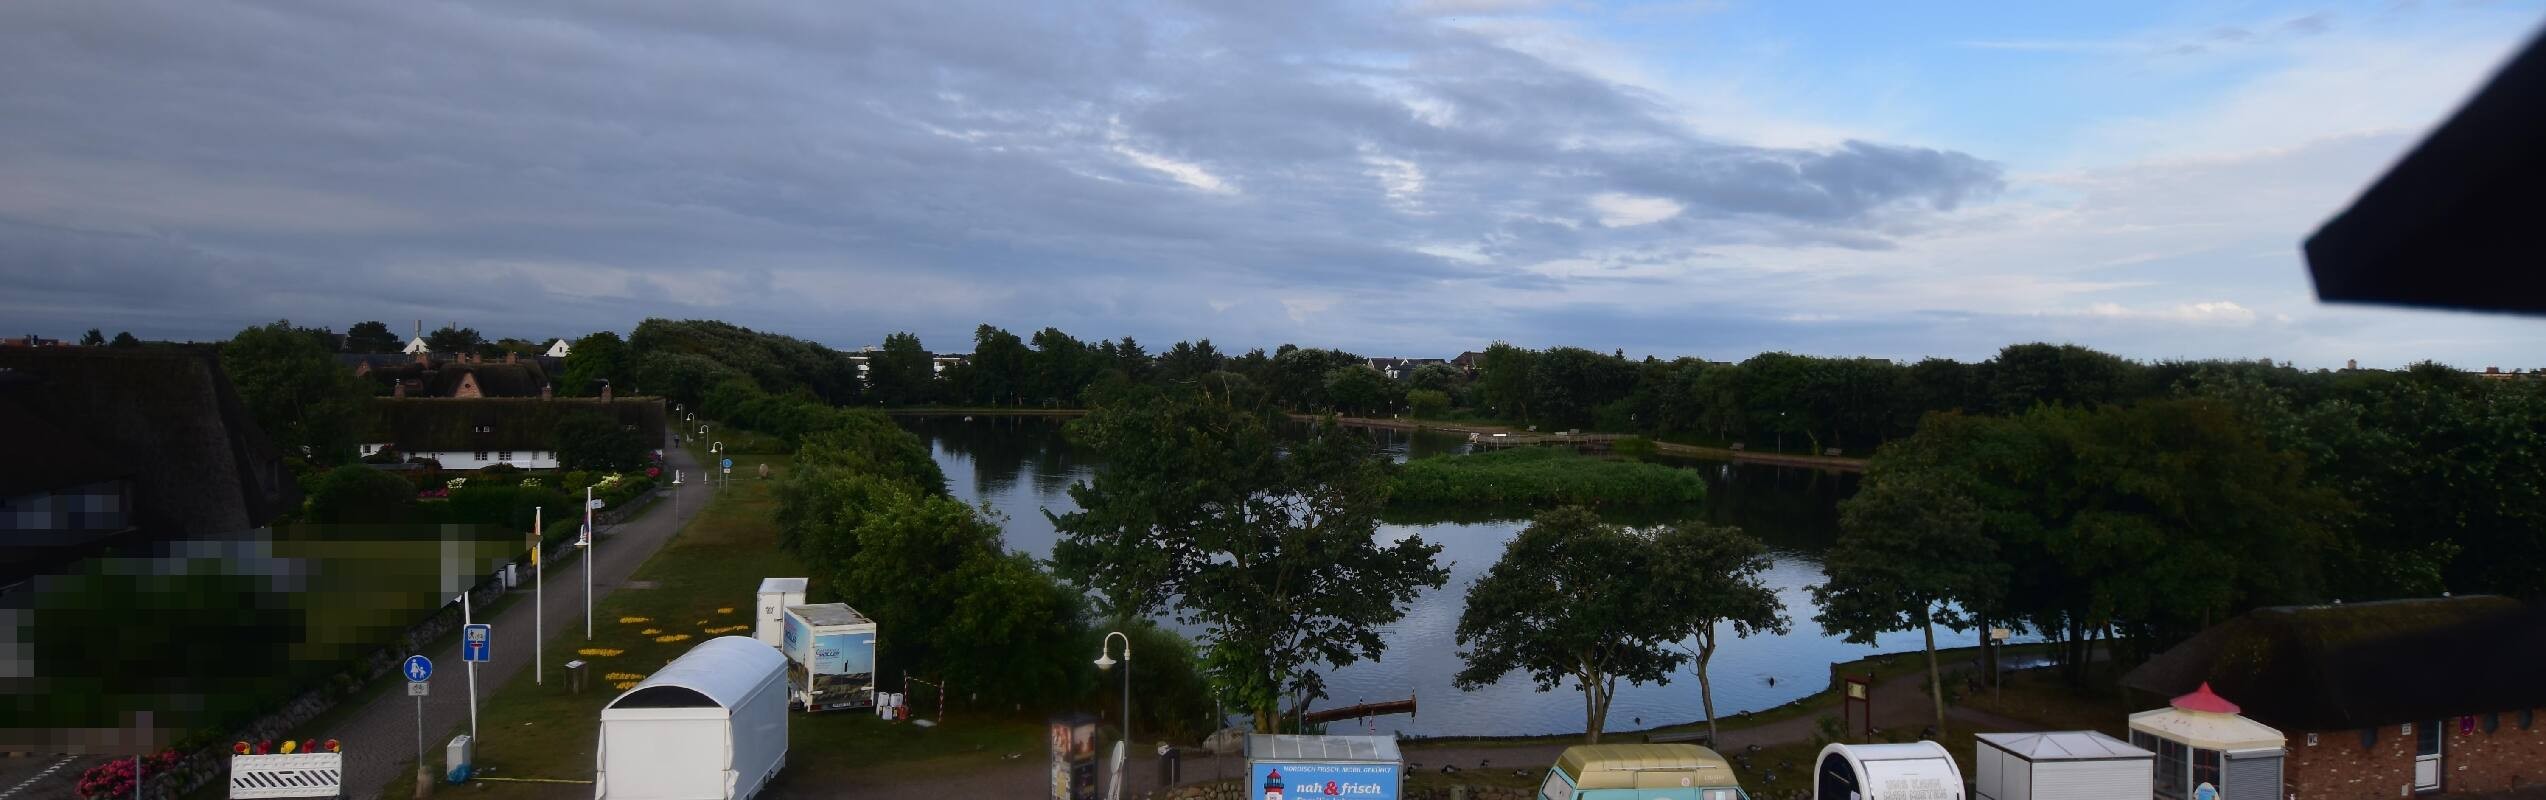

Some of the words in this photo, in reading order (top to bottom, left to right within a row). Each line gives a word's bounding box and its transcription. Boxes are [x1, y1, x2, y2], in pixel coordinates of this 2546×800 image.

[1296, 782, 1322, 793] nah
[1323, 781, 1339, 795] &
[1340, 782, 1380, 796] frisch
